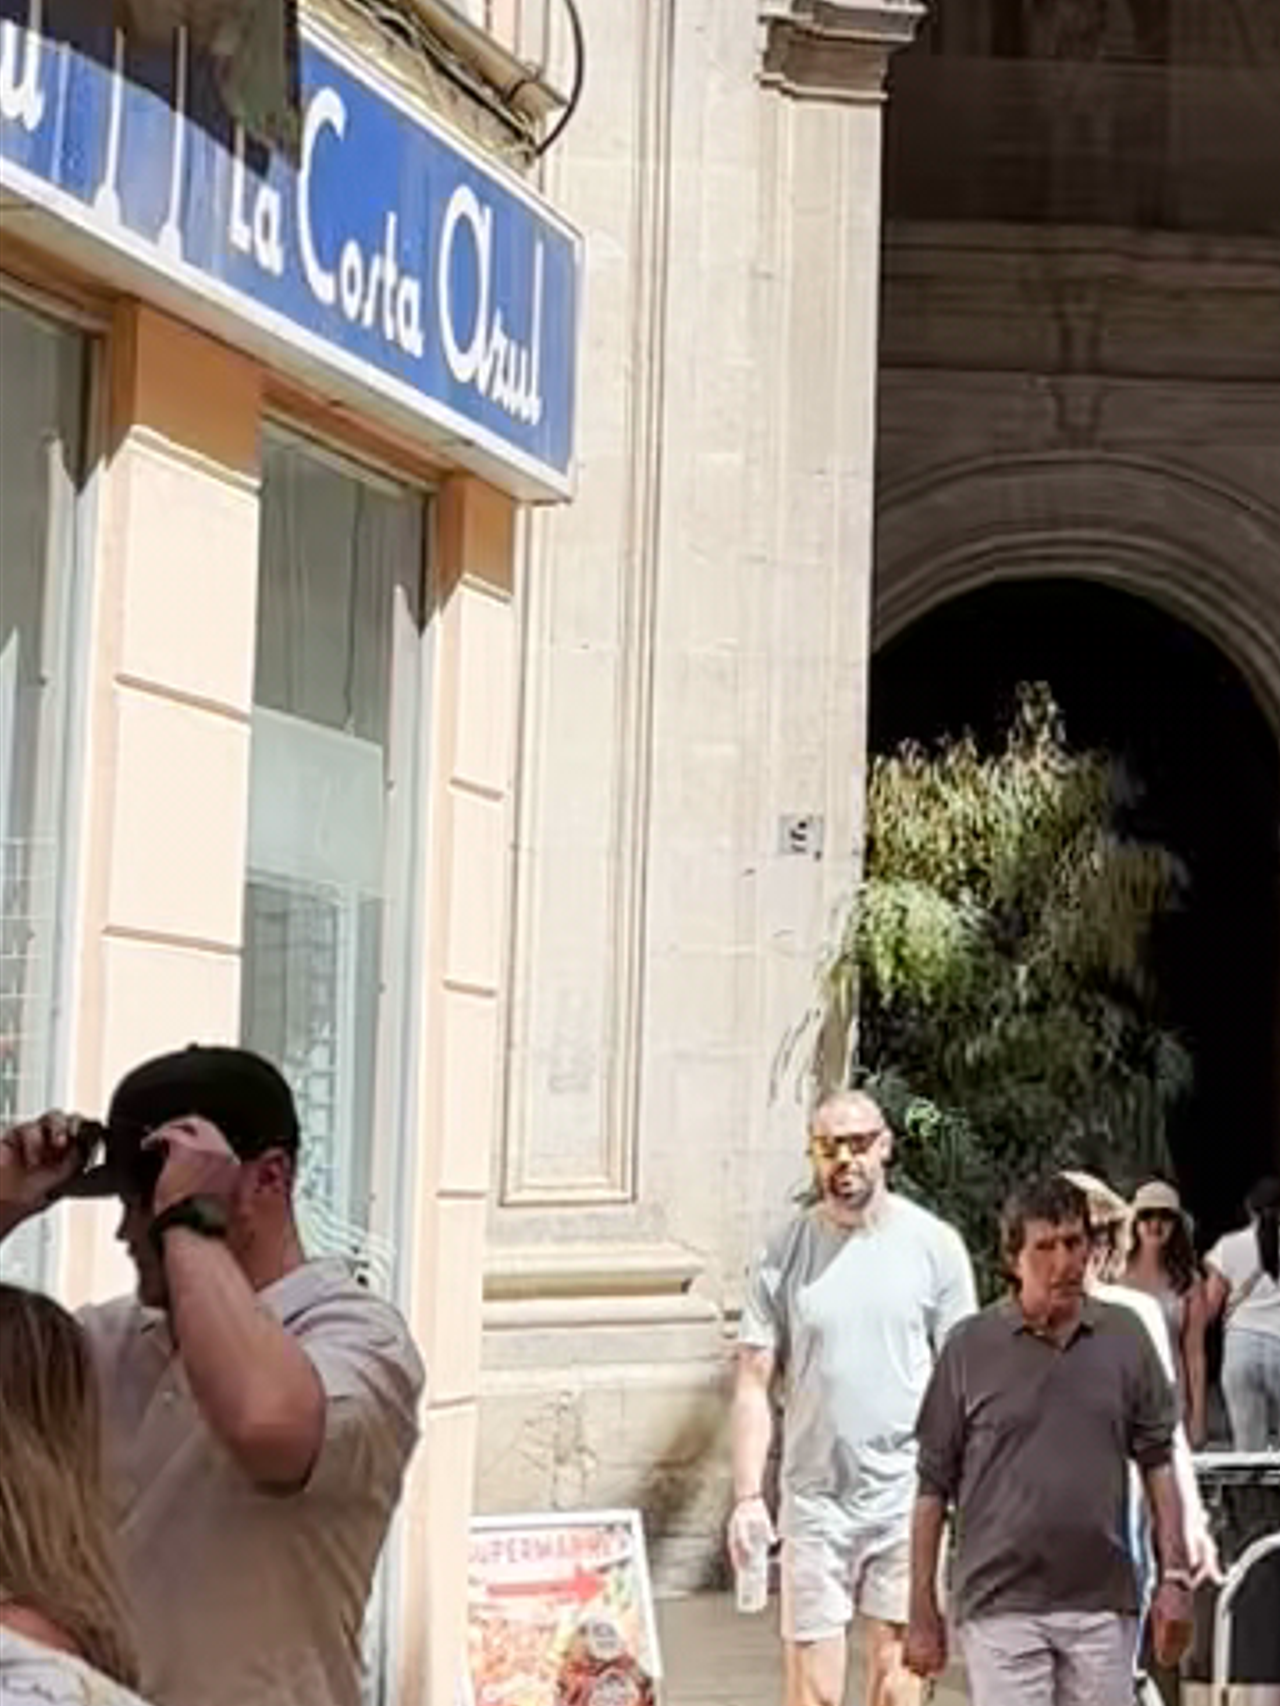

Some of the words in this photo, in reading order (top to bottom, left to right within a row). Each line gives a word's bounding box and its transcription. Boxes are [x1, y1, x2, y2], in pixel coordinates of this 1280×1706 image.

[228, 122, 284, 276] La
[297, 88, 424, 358] Costa
[438, 185, 544, 427] Azul
